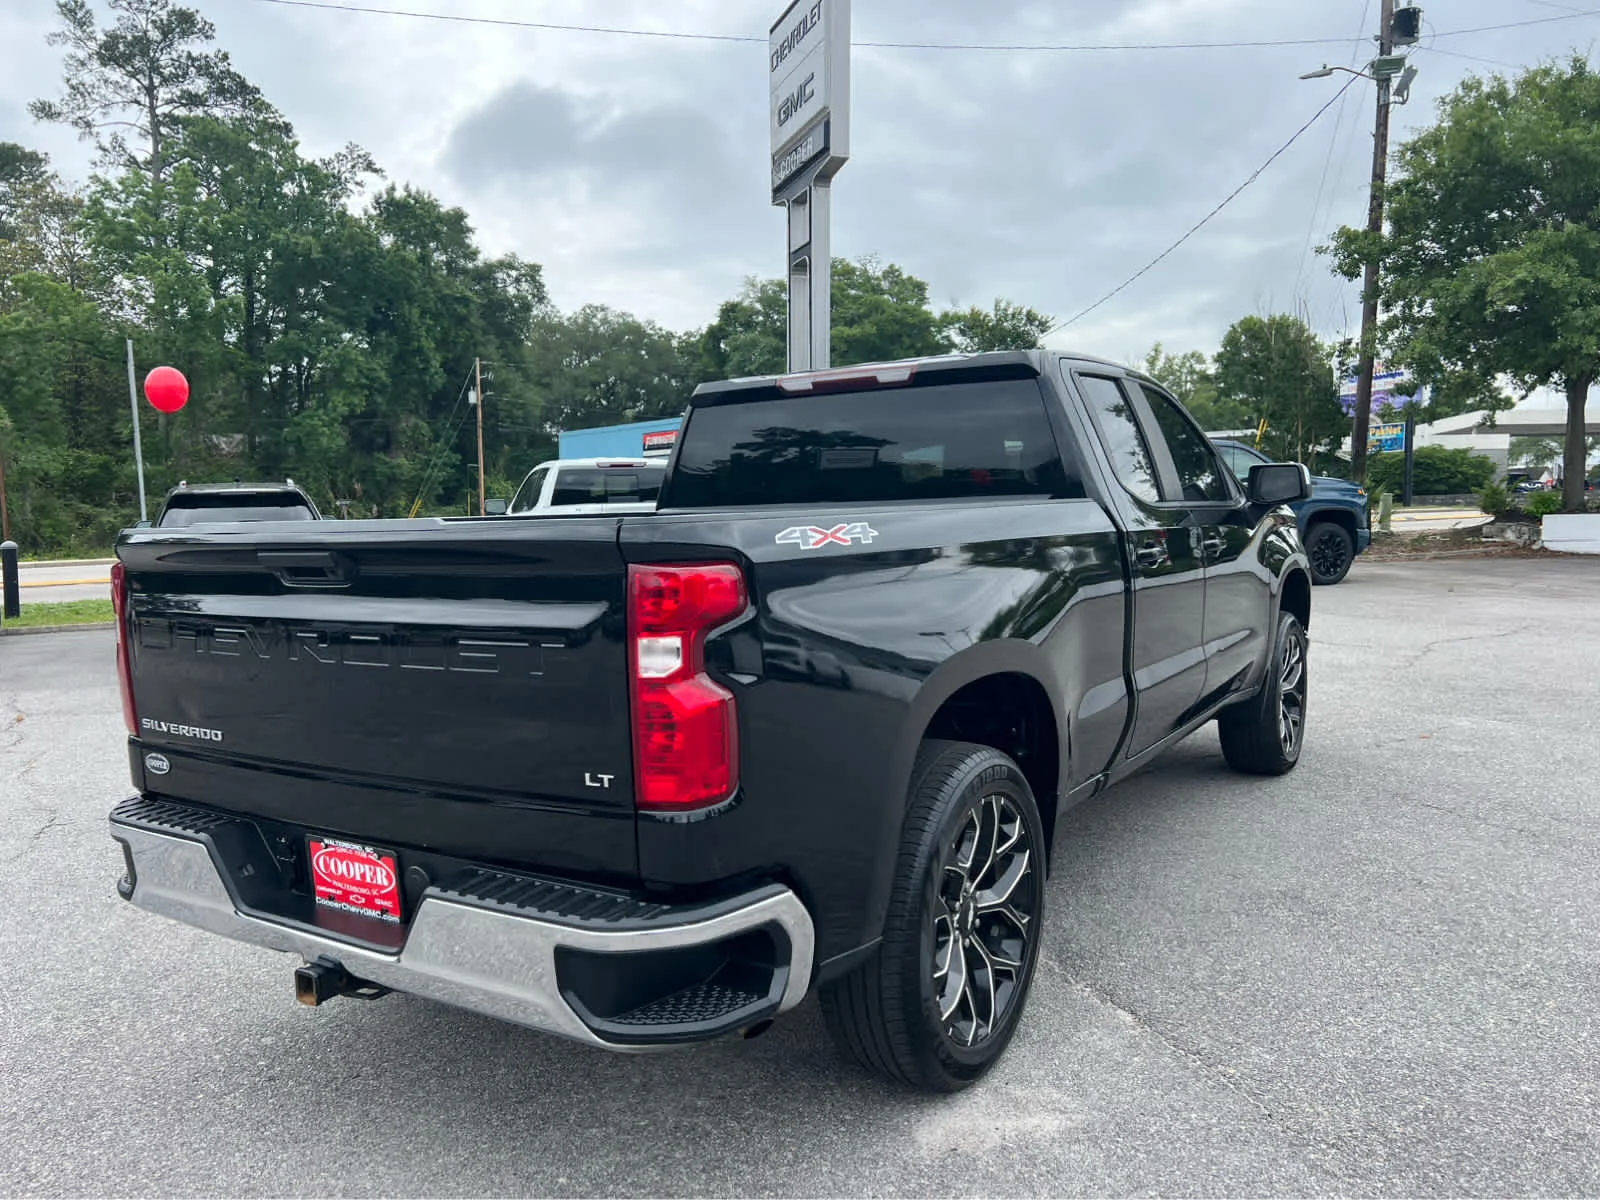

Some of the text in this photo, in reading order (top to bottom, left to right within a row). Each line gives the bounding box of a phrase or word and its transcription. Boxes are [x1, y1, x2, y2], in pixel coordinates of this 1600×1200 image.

[771, 0, 822, 73] CHEVROLET
[777, 72, 815, 128] GMC
[779, 136, 814, 179] COOPER
[141, 718, 223, 742] SILVERADO
[584, 772, 615, 788] LT
[319, 855, 390, 886] COOPER
